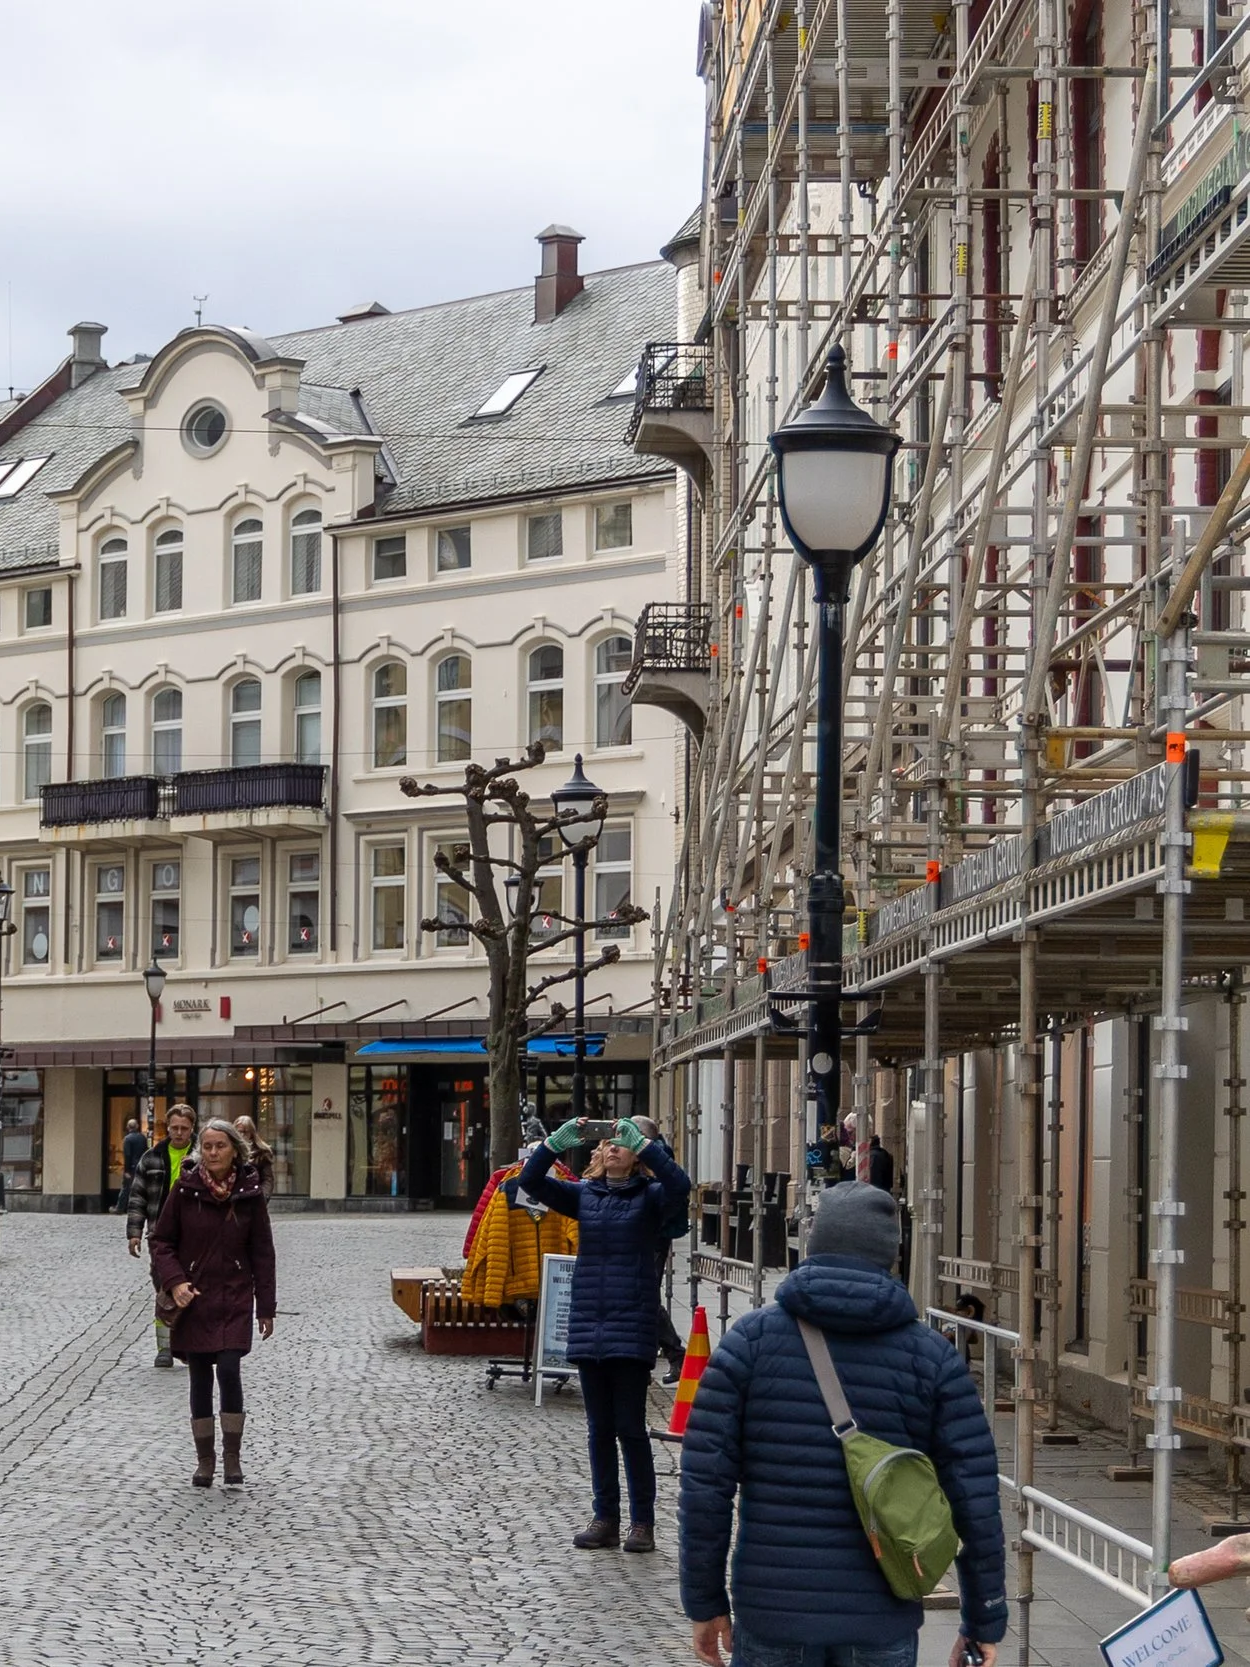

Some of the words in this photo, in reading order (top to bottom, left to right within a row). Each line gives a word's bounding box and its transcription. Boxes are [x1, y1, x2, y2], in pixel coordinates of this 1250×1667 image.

[1050, 794, 1106, 856] NORWEGIAN
[1109, 774, 1147, 831] GROUP
[1149, 764, 1166, 813] AS
[952, 846, 994, 900] NORWEGIAN
[173, 999, 210, 1009] MONARK
[1121, 1614, 1192, 1667] WELCOME
